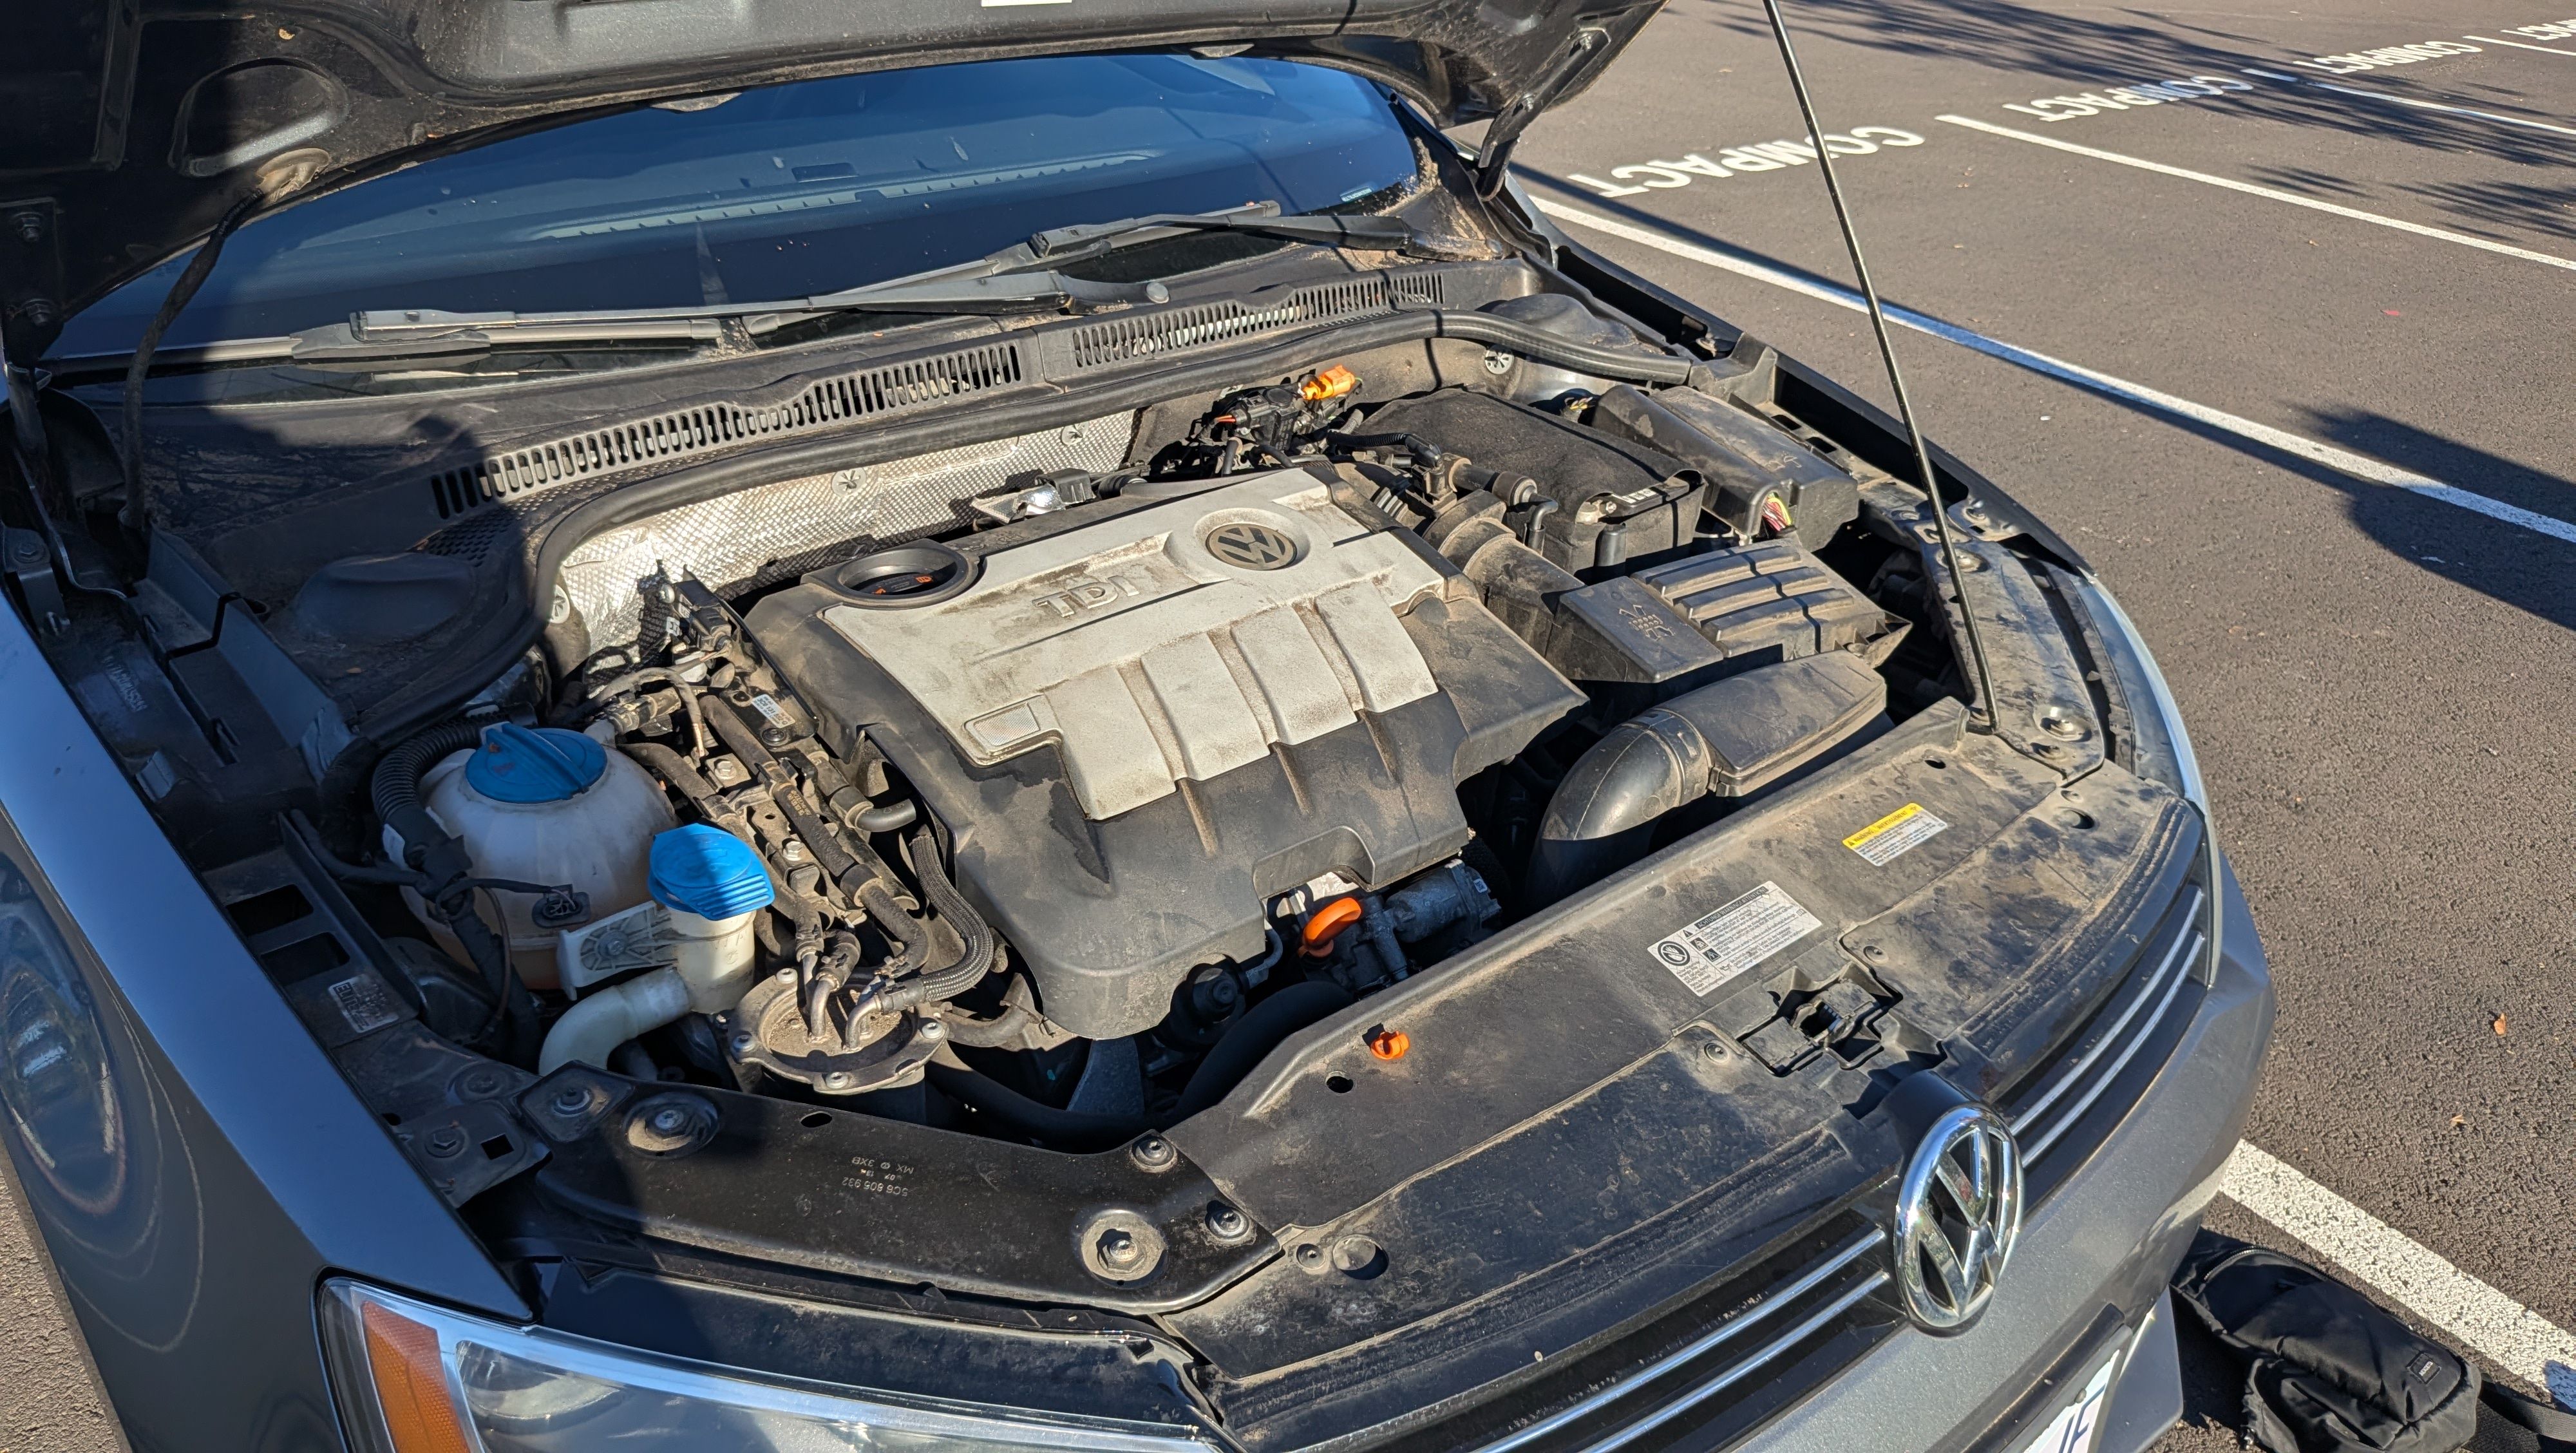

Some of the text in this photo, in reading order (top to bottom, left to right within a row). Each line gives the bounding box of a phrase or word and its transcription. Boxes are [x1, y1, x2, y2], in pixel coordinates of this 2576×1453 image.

[2293, 41, 2483, 74] COMPACT
[2002, 75, 2254, 122] COMPACT
[1567, 126, 1925, 198] COMPACT
[1032, 575, 1139, 618] TDI
[1698, 886, 1766, 929] ACHTUNG! WARNING! ATTENTION!
[851, 1156, 914, 1174] MX 3XB
[841, 1177, 909, 1197] 5C6 805 932
